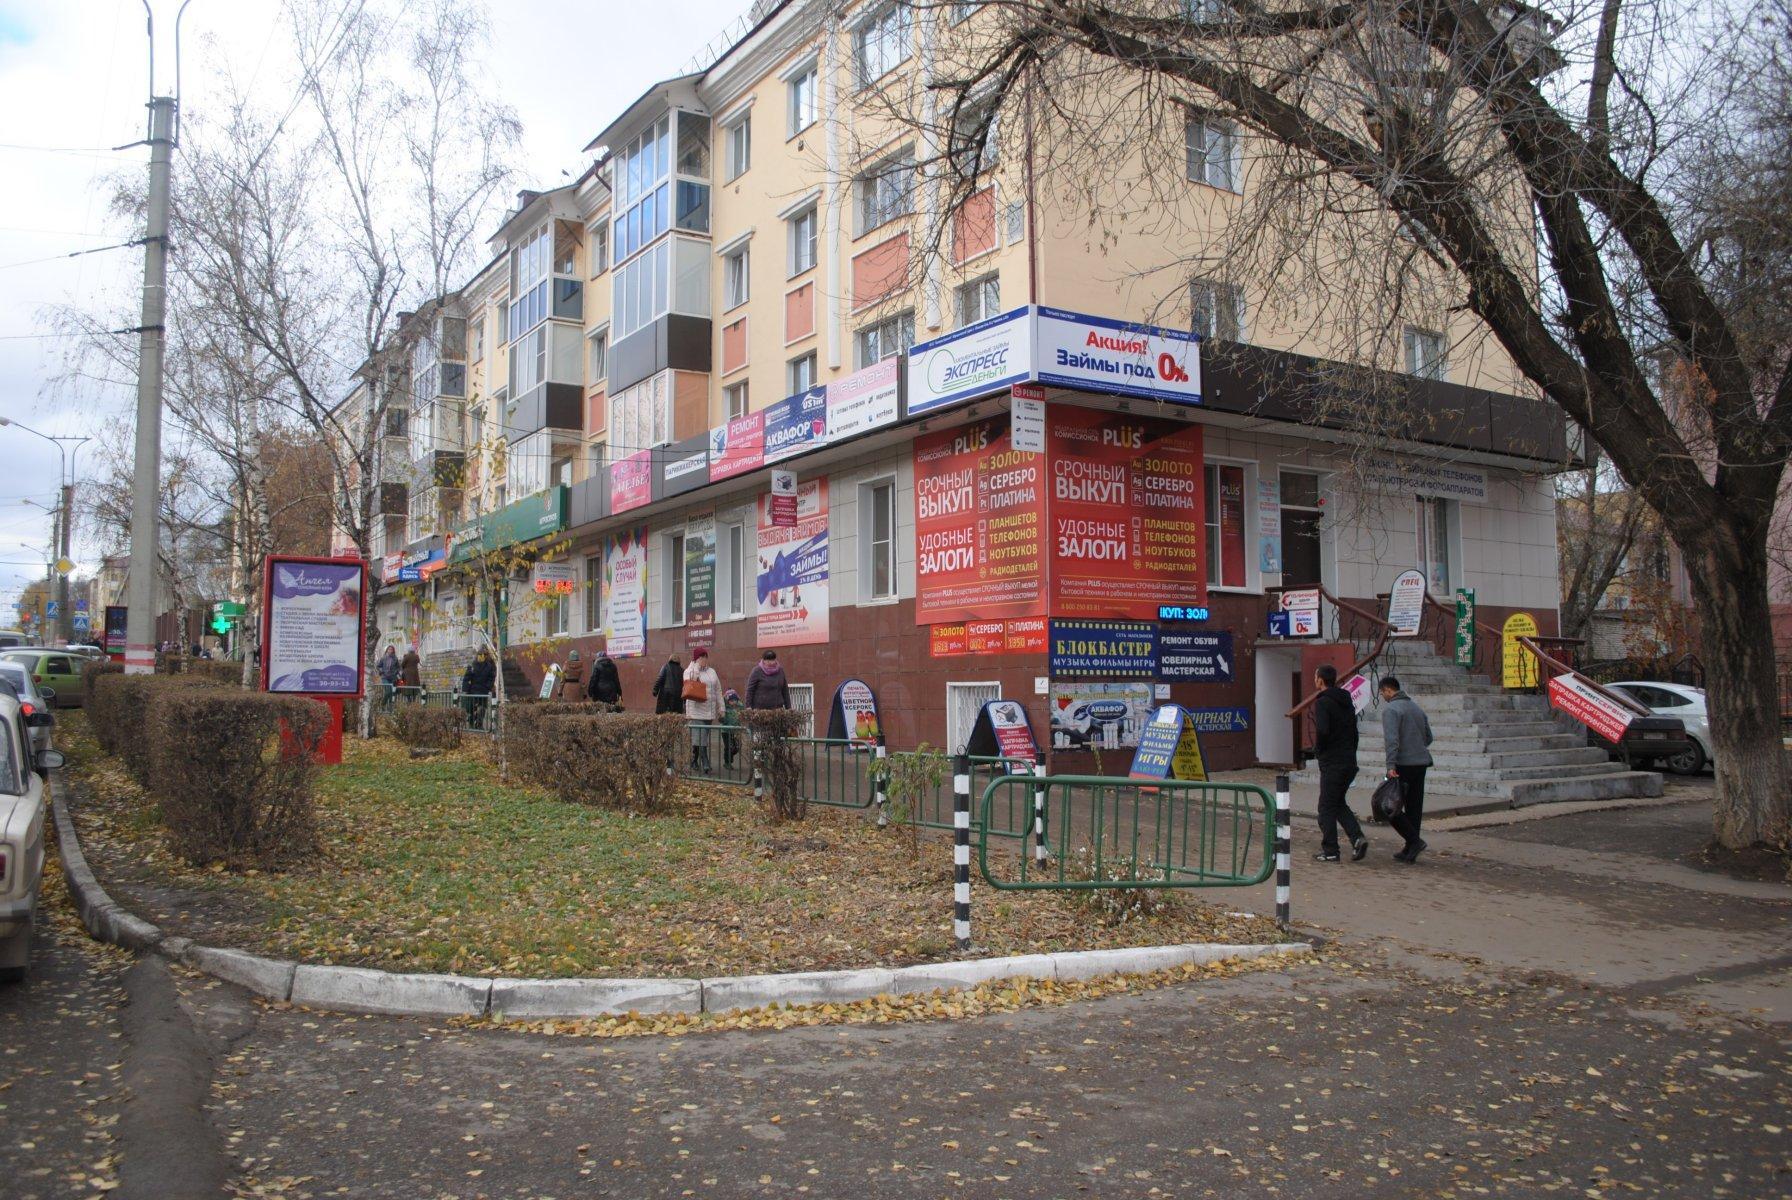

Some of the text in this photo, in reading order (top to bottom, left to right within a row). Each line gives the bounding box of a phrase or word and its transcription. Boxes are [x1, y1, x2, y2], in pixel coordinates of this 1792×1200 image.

[1086, 331, 1147, 355] Акция!
[943, 348, 1009, 382] ЭКСПРЕСС
[1056, 348, 1189, 382] Займы под 0%
[840, 364, 895, 393] РЕМОНТ
[972, 366, 1006, 384] ДЕНЬГИ
[1022, 390, 1043, 398] РЕМОНТ
[731, 416, 759, 436] РЕМОНТ
[766, 421, 811, 446] АКВАФОР
[990, 450, 1035, 470] ЗОЛОТО
[1145, 458, 1193, 475] ЗОЛОТО
[990, 467, 1036, 490] СЕРЕБРО
[1054, 459, 1126, 482] СРОЧНЫЙ
[1442, 470, 1483, 484] ТЕЛЕФОНОВ
[918, 468, 973, 496] СРОЧНЫЙ
[1056, 476, 1125, 504] ВЫКУП
[1145, 476, 1194, 493] СЕРЕБРО
[919, 486, 973, 518] ВЫКУП
[990, 487, 1036, 510] ПЛАТИНА
[1145, 492, 1194, 509] ПЛАТИНА
[989, 512, 1037, 530] ПЛАНШЕТОВ
[1058, 518, 1126, 538] УДОБНЫЕ
[1144, 517, 1196, 532] ПЛАНШЕТОВ
[758, 520, 825, 547] ВЫДАЧА ЗАЙМОВ
[919, 527, 973, 552] УДОБНЫЕ
[990, 527, 1037, 544] ТЕЛЕФОНОВ
[1144, 532, 1196, 544] ТЕЛЕФОНОВ
[990, 544, 1038, 560] НОУТБУКОВ
[1058, 536, 1126, 560] ЗАЛОГИ
[1144, 546, 1197, 558] НОУТБУКОВ
[616, 555, 637, 571] ОСОБЫЙ
[790, 550, 827, 576] ЗАЙМЫ!
[920, 546, 974, 575] ЗАЛОГИ
[990, 560, 1038, 576] РАДИОДЕТАЛЕЙ
[1145, 561, 1197, 572] РАДИОДЕТАЛЕЙ
[616, 568, 637, 583] СЛУЧАЙ
[1060, 579, 1087, 588] Компания
[1136, 582, 1162, 590] СРОЧНЫЙ
[1060, 587, 1084, 596] бытовой
[940, 627, 964, 637] ЗОЛОТО
[976, 624, 1004, 634] СЕРЕБРО
[1015, 620, 1044, 632] ПЛАТИНА
[1056, 640, 1152, 656] БЛОКБАСТЕР
[1161, 636, 1218, 646] РЕМОНТ ОБУВИ
[1053, 658, 1156, 668] МУЗЫКА ФИЛЬМЫ ИГРЫ
[1162, 656, 1213, 664] ЮВЕЛИРНАЯ
[1162, 666, 1215, 676] МАСТЕРСКАЯ
[1548, 680, 1581, 704] ЗАПРАВКА
[1091, 705, 1124, 713] АКВАФОР
[1555, 694, 1620, 740] РЕМОНТ ПРИНТЕРОВ
[1145, 732, 1176, 741] МУЗЫКА
[1196, 724, 1232, 732] АСТЕРСКАЯ
[1142, 740, 1174, 750] ФИЛЬМЫ
[1138, 754, 1168, 766] ИГРЫ
